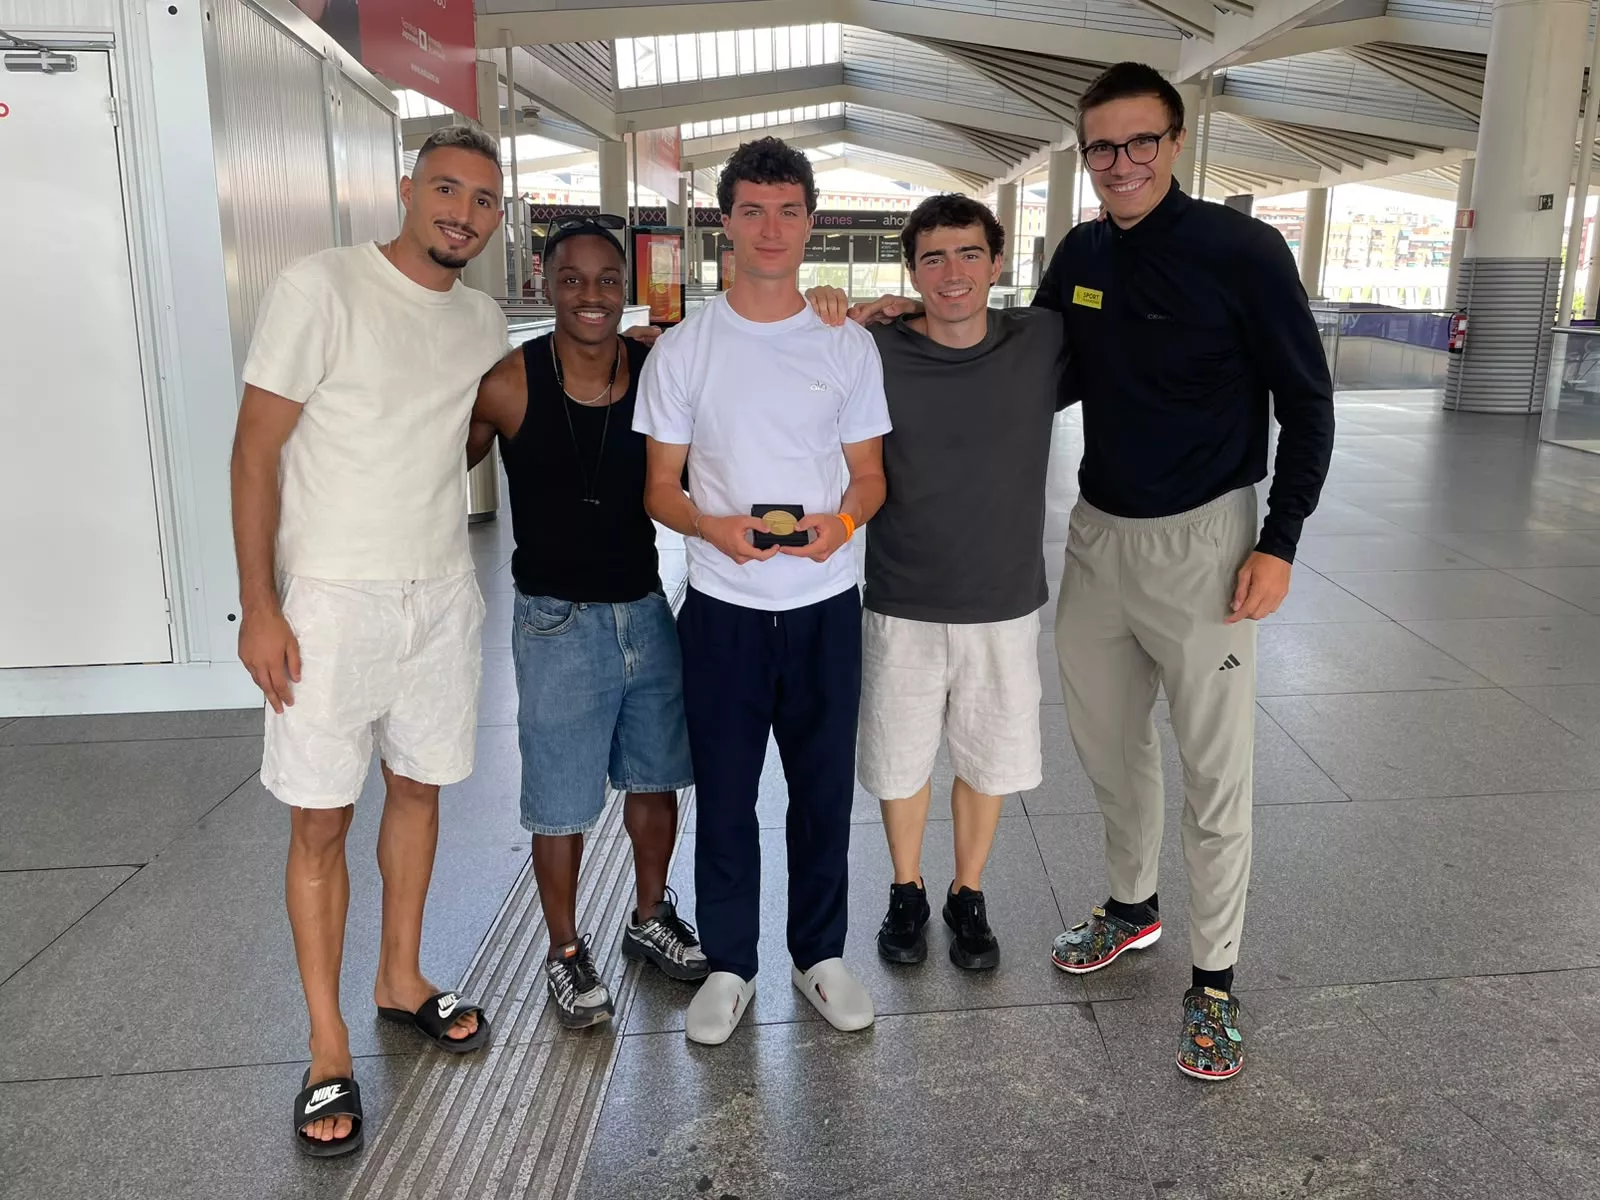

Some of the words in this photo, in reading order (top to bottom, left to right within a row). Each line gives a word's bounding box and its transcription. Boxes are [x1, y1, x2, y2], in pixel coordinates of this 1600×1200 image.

[814, 213, 853, 225] Trenes
[1083, 292, 1100, 300] SPORT
[437, 993, 457, 1010] NIKE
[311, 1083, 342, 1103] NIKE
